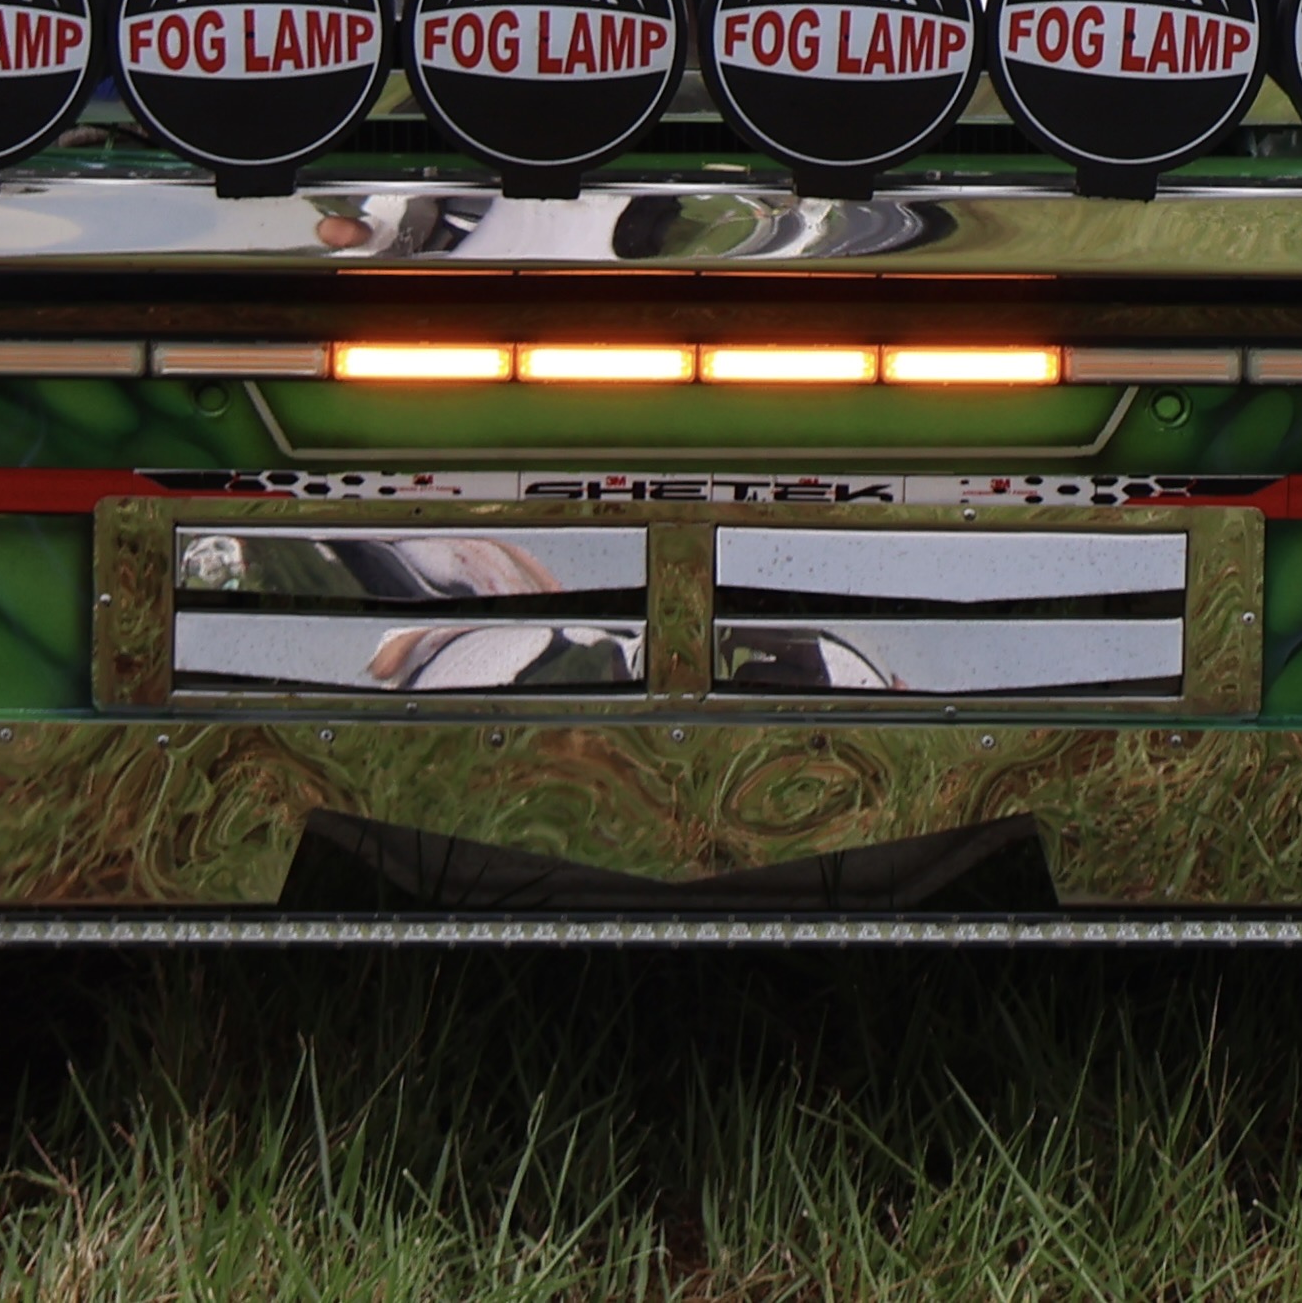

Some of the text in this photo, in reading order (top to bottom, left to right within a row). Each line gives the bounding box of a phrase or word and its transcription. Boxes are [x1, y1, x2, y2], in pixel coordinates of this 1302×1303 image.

[130, 10, 373, 72] FOG LAMP
[425, 11, 667, 74] FOG LAMP
[725, 10, 966, 74] FOG LAMP
[1009, 6, 1250, 73] FOG LAMP
[605, 475, 627, 487] 3M
